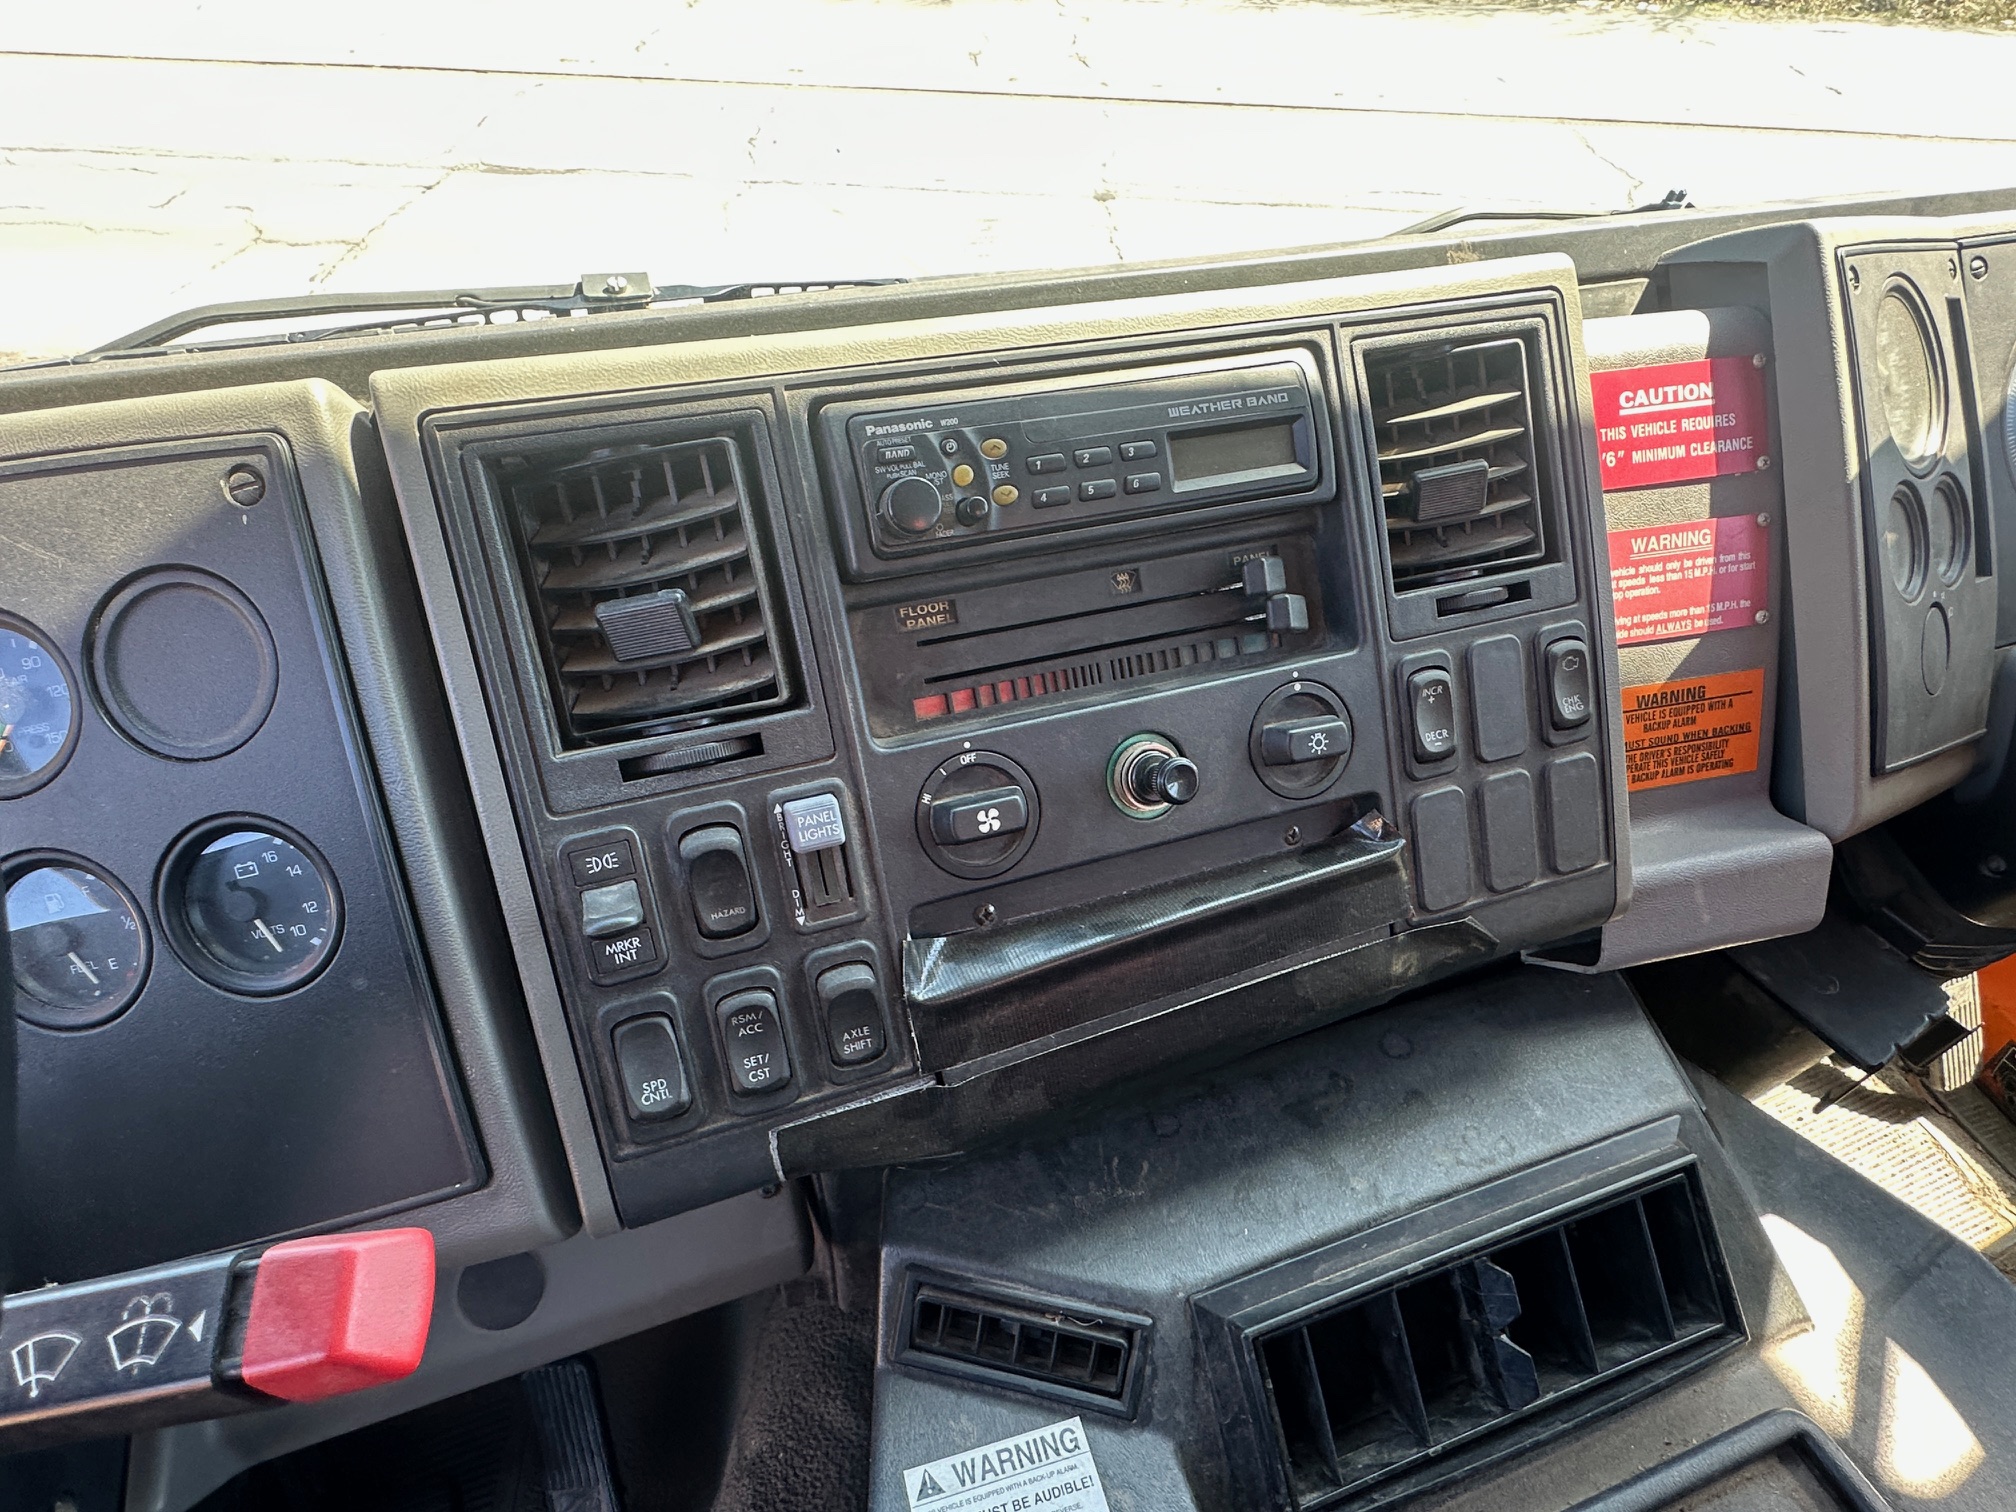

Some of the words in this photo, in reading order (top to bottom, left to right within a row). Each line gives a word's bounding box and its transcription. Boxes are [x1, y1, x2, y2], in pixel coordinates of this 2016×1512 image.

[1619, 382, 1713, 408] CAUTION
[1168, 398, 1242, 418] WEATHER
[1246, 392, 1288, 407] BAND
[866, 418, 933, 436] Panasonic
[940, 418, 958, 427] W200
[1600, 426, 1626, 442] THIS
[1630, 420, 1677, 438] VEHICLE
[1681, 413, 1736, 432] REQUIRES
[885, 449, 910, 459] BAND
[1128, 447, 1135, 457] 3
[1632, 444, 1686, 464] MINIMUM
[1690, 436, 1753, 456] CLEARANCE
[913, 460, 926, 469] BAL
[1036, 460, 1041, 470] 1
[1083, 453, 1090, 464] 2
[900, 470, 917, 478] SCAN
[991, 462, 1009, 472] TUNE
[925, 470, 947, 480] MONO
[934, 478, 944, 486] ST
[992, 470, 1010, 480] SEEK
[1133, 478, 1140, 488] 6
[1040, 493, 1047, 503] 4
[1088, 486, 1095, 496] 5
[1631, 528, 1711, 553] WARNING
[1639, 562, 1663, 574] should
[1666, 560, 1681, 571] only
[1684, 558, 1693, 568] be
[1695, 556, 1716, 566] driven
[1719, 554, 1735, 563] from
[1738, 551, 1750, 560] this
[1618, 576, 1646, 590] speeds
[1649, 574, 1665, 583] less
[1666, 572, 1682, 581] than
[1684, 569, 1693, 578] 15
[1719, 566, 1726, 574] or
[1728, 563, 1738, 572] for
[1740, 561, 1756, 571] start
[1625, 586, 1661, 600] operation.
[900, 601, 949, 618] FLOOR
[1633, 614, 1640, 623] at
[1642, 610, 1668, 624] speeds
[1669, 609, 1688, 618] more
[1689, 606, 1704, 615] than
[1706, 604, 1715, 612] 15
[1740, 599, 1751, 608] the
[906, 613, 955, 629] PANEL
[1630, 626, 1654, 637] should
[1656, 619, 1692, 634] ALWAYS
[1694, 619, 1703, 628] be
[22, 656, 41, 670] 90
[47, 684, 69, 698] 120
[1422, 686, 1443, 697] INCR
[1636, 686, 1706, 708] WARNING
[1562, 694, 1580, 706] CHK
[1564, 703, 1584, 714] ENG
[1626, 710, 1656, 724] VEHICLE
[1659, 710, 1666, 720] IS
[1669, 703, 1705, 718] EQUIPPED
[1708, 700, 1726, 712] WITH
[1728, 699, 1733, 708] A
[19, 722, 51, 734] PRESS
[1643, 720, 1670, 733] BACKUP
[1672, 716, 1696, 728] ALARM
[46, 730, 68, 744] 150
[1426, 729, 1449, 741] DECR
[1648, 733, 1679, 746] SOUND
[1683, 729, 1708, 741] WHEN
[1712, 722, 1751, 736] BACKING
[1639, 748, 1671, 761] DRIVER'S
[1674, 738, 1729, 756] RESPONSIBILITY
[960, 752, 976, 765] OFF
[1626, 761, 1650, 774] PERATE
[1653, 758, 1668, 769] THIS
[1670, 752, 1699, 766] VEHICLE
[1701, 750, 1725, 761] SAFELY
[1632, 772, 1659, 784] BACKUP
[1661, 767, 1685, 779] ALARM
[1687, 766, 1694, 774] IS
[1696, 758, 1734, 773] OPERATING
[922, 793, 932, 804] HI
[797, 812, 837, 827] PANEL
[776, 813, 792, 867] BRIGHT
[799, 823, 840, 842] LIGHTS
[262, 851, 278, 863] 16
[286, 865, 302, 877] 14
[81, 886, 90, 897] F
[302, 901, 319, 914] 12
[792, 890, 804, 917] DIM
[711, 906, 745, 920] HAZARD
[251, 924, 285, 940] VOTS
[290, 924, 306, 937] 10
[606, 937, 641, 956] MRKR
[108, 958, 119, 970] E
[614, 949, 637, 965] INT
[731, 1011, 763, 1026] RSM/
[738, 1023, 763, 1037] ACC
[843, 1026, 871, 1042] AXLE
[844, 1039, 872, 1055] SHIFT
[743, 1053, 770, 1069] SET/
[748, 1068, 771, 1082] CST
[643, 1079, 666, 1094] SPD
[641, 1089, 673, 1106] CNTL
[951, 1426, 1081, 1488] WARNING
[937, 1500, 965, 1512] VEHICLE
[973, 1487, 1005, 1503] EQUIPPED
[1005, 1482, 1022, 1492] WITH
[1028, 1471, 1055, 1485] BACK-UP
[1012, 1496, 1031, 1511] BE
[1034, 1475, 1095, 1505] AUDIBLE!
